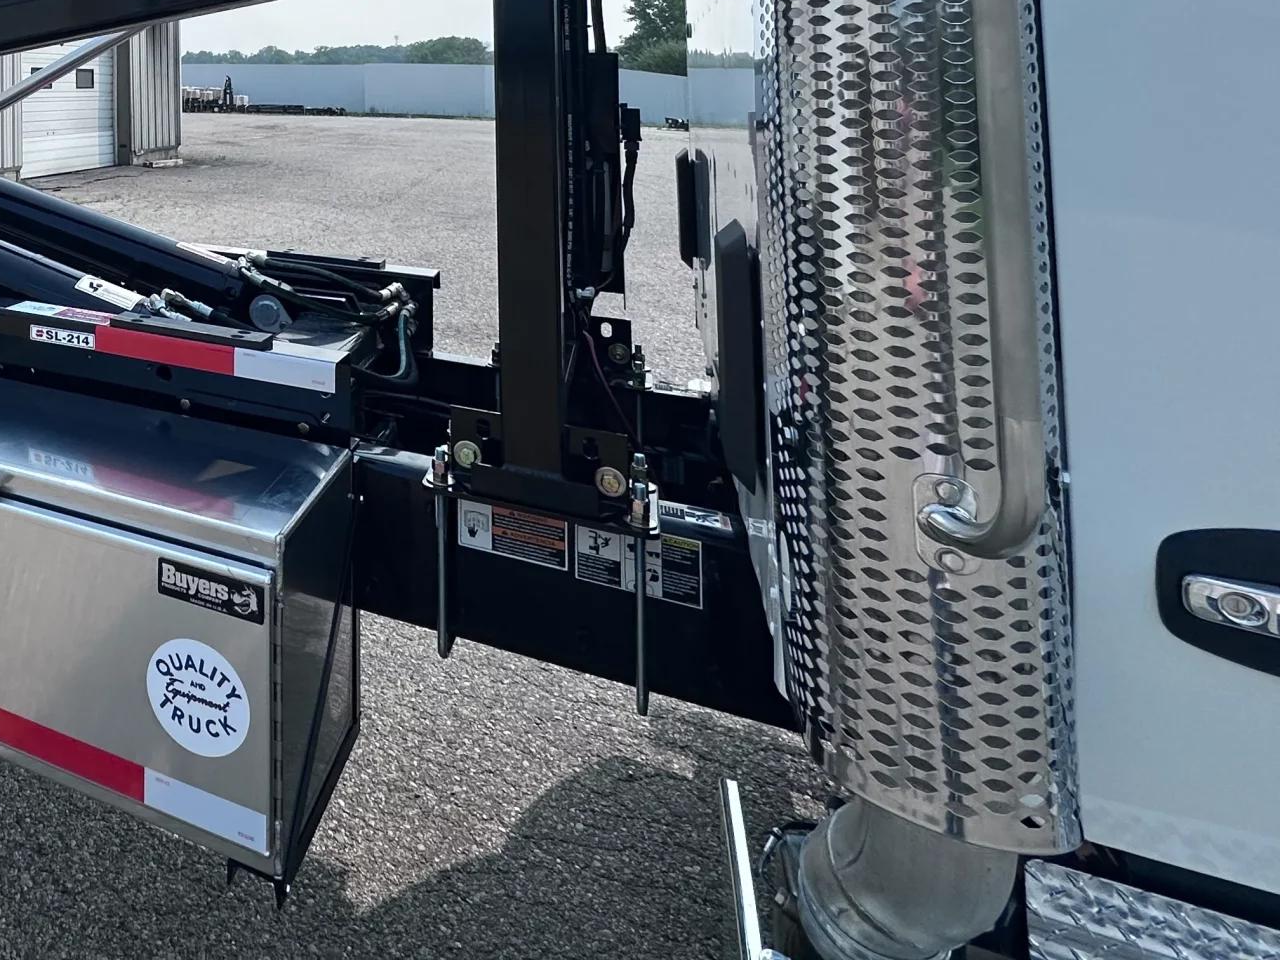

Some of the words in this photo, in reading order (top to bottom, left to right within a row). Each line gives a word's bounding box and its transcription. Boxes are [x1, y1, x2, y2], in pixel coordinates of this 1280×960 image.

[45, 330, 90, 347] SL-214
[161, 562, 229, 601] Buyers
[155, 653, 242, 701] QUALITY
[165, 678, 230, 713] Equipment
[189, 680, 206, 692] AND
[159, 694, 237, 739] TRUCK
